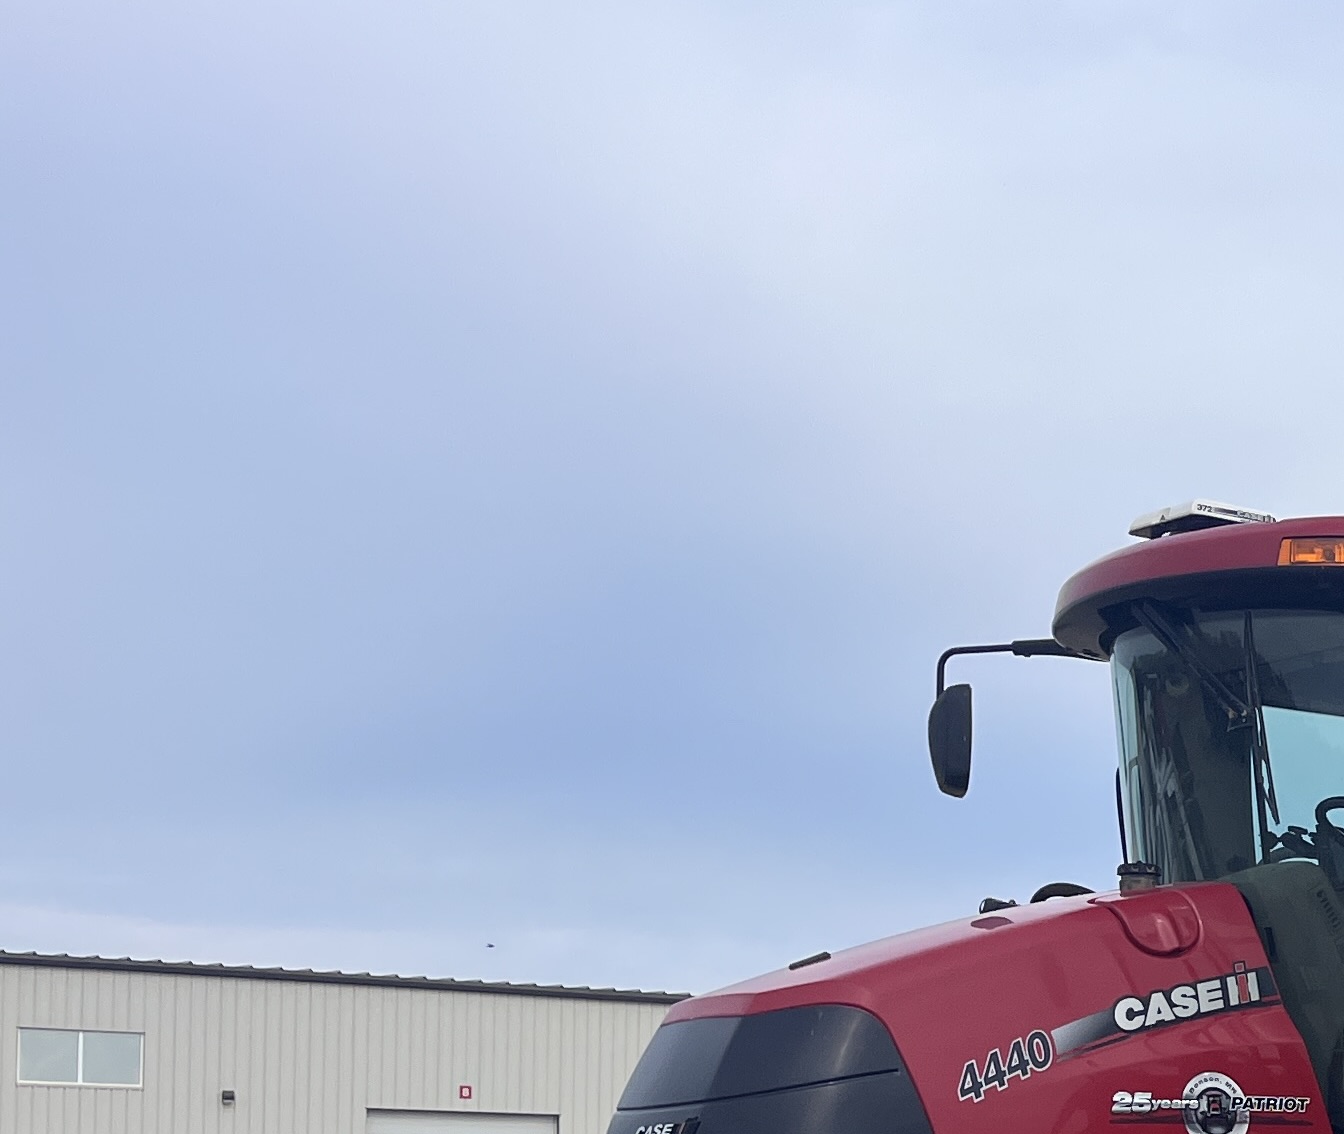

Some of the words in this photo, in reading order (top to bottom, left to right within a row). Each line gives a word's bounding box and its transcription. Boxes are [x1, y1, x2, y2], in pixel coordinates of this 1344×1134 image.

[1197, 503, 1213, 512] 372
[1114, 978, 1224, 1031] CASE
[958, 1030, 1052, 1103] 4440
[1111, 1091, 1152, 1114] 25
[1150, 1098, 1200, 1114] years
[1229, 1096, 1311, 1112] PATRIOT
